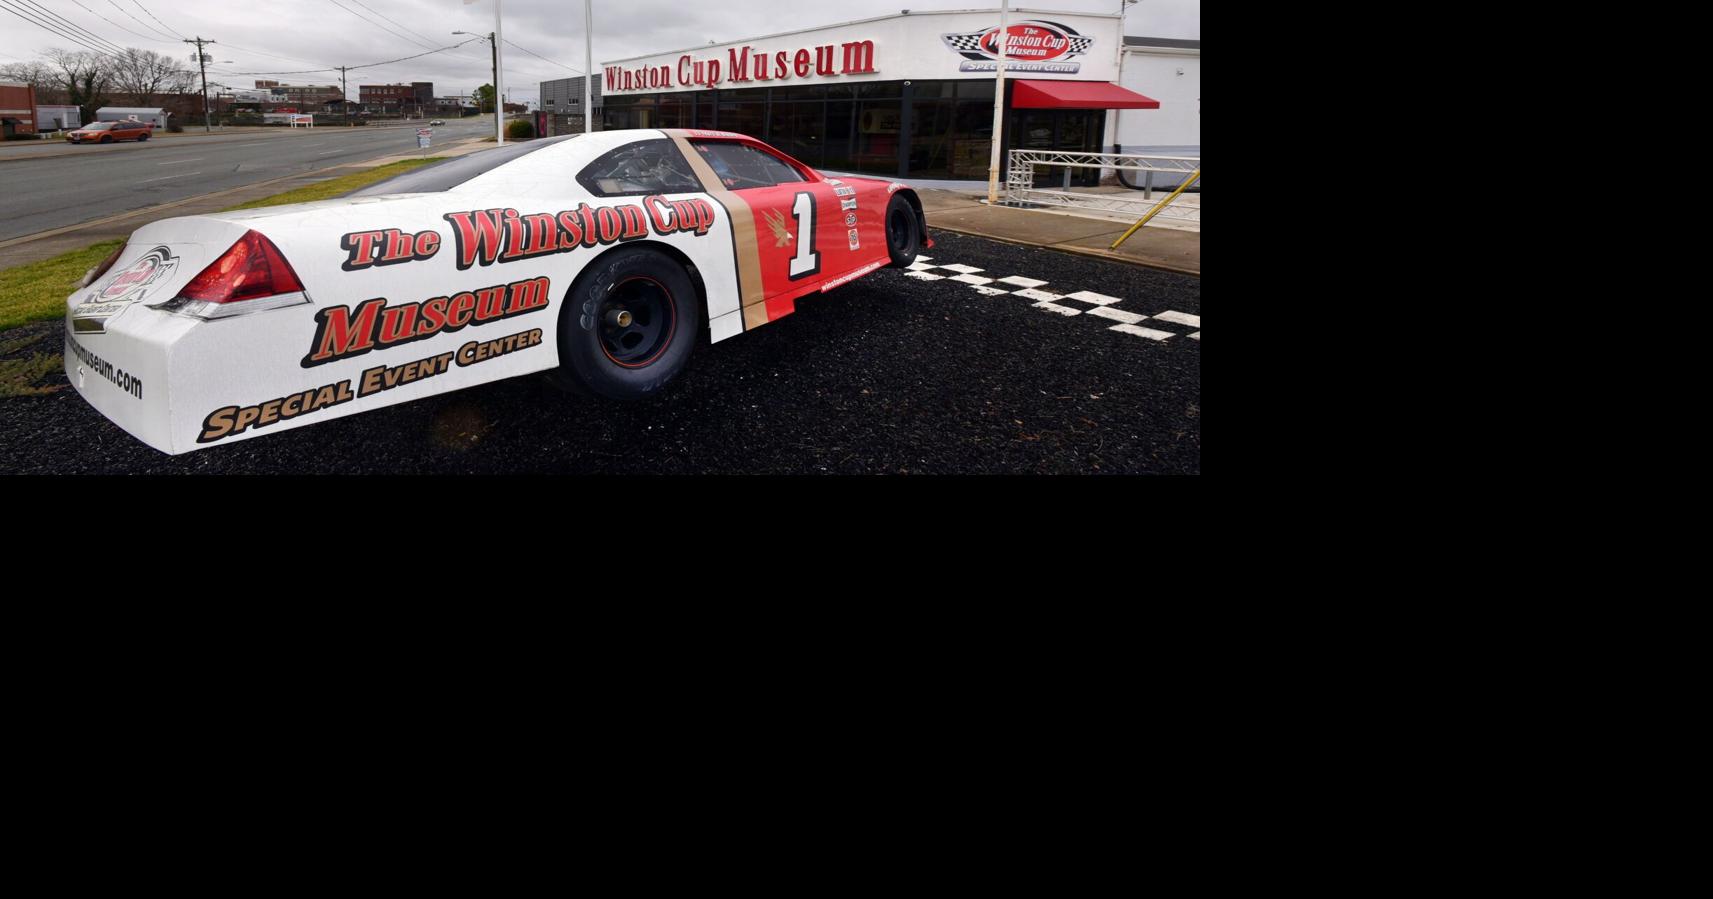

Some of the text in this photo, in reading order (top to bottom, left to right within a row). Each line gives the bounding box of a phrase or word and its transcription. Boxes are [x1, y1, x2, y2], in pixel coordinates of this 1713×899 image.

[1006, 46, 1047, 56] Museum
[1024, 27, 1039, 35] The
[1043, 34, 1066, 50] Cup
[605, 39, 876, 92] Winston Cup Museum
[967, 62, 1015, 71] SPECAL
[342, 226, 441, 271] The
[444, 202, 649, 270] Winston
[643, 194, 715, 237] Cup
[789, 192, 819, 279] 1
[301, 275, 550, 368] Museum
[196, 328, 543, 443] SPECIAL EVENT CENTER
